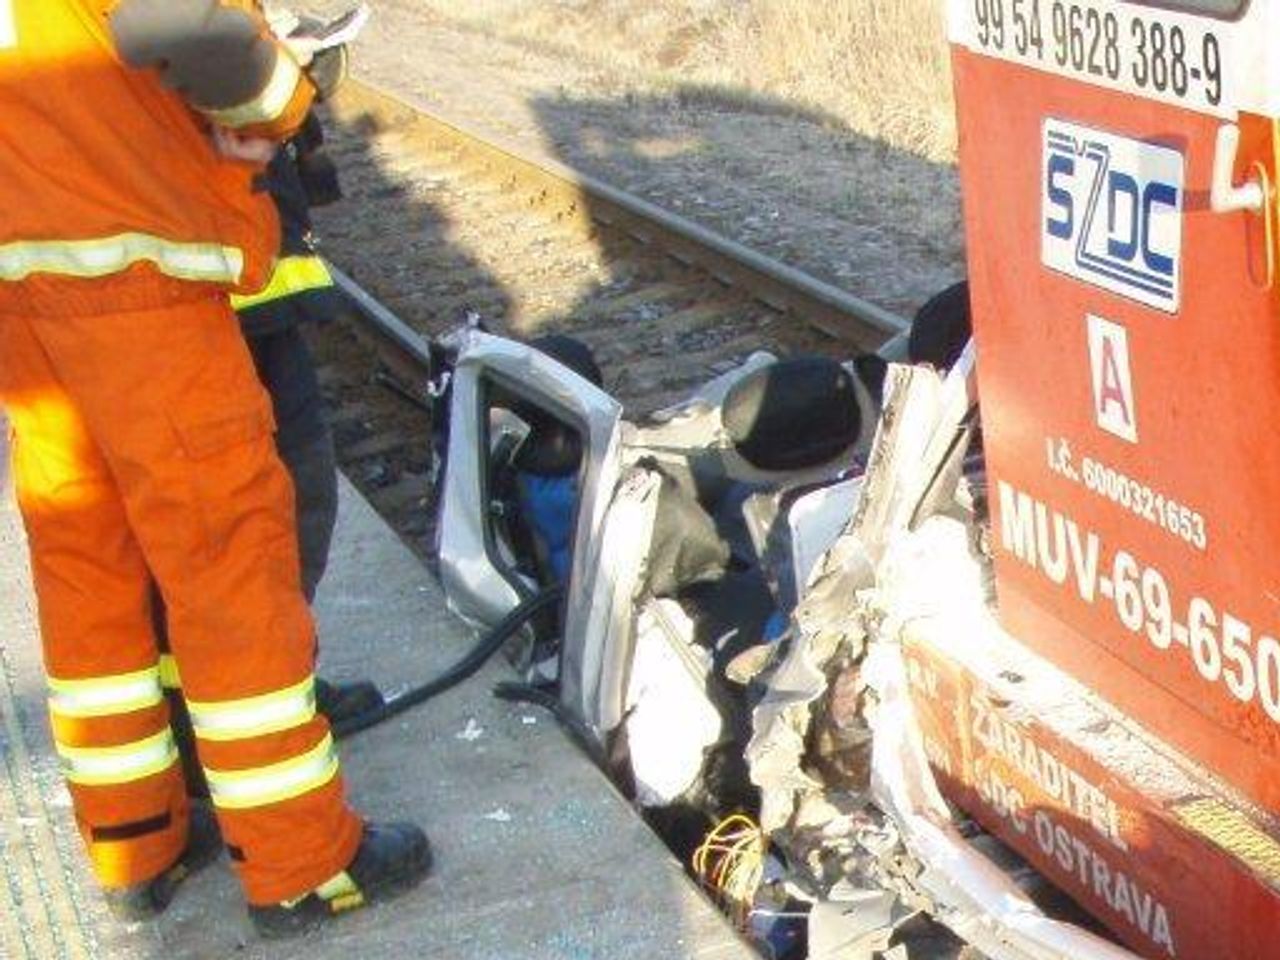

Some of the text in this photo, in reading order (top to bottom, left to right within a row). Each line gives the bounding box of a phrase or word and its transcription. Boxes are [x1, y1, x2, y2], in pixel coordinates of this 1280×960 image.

[974, 0, 1222, 105] 99 54 9628 388-9
[1100, 335, 1130, 427] A
[1034, 809, 1176, 958] OSTRAVA
